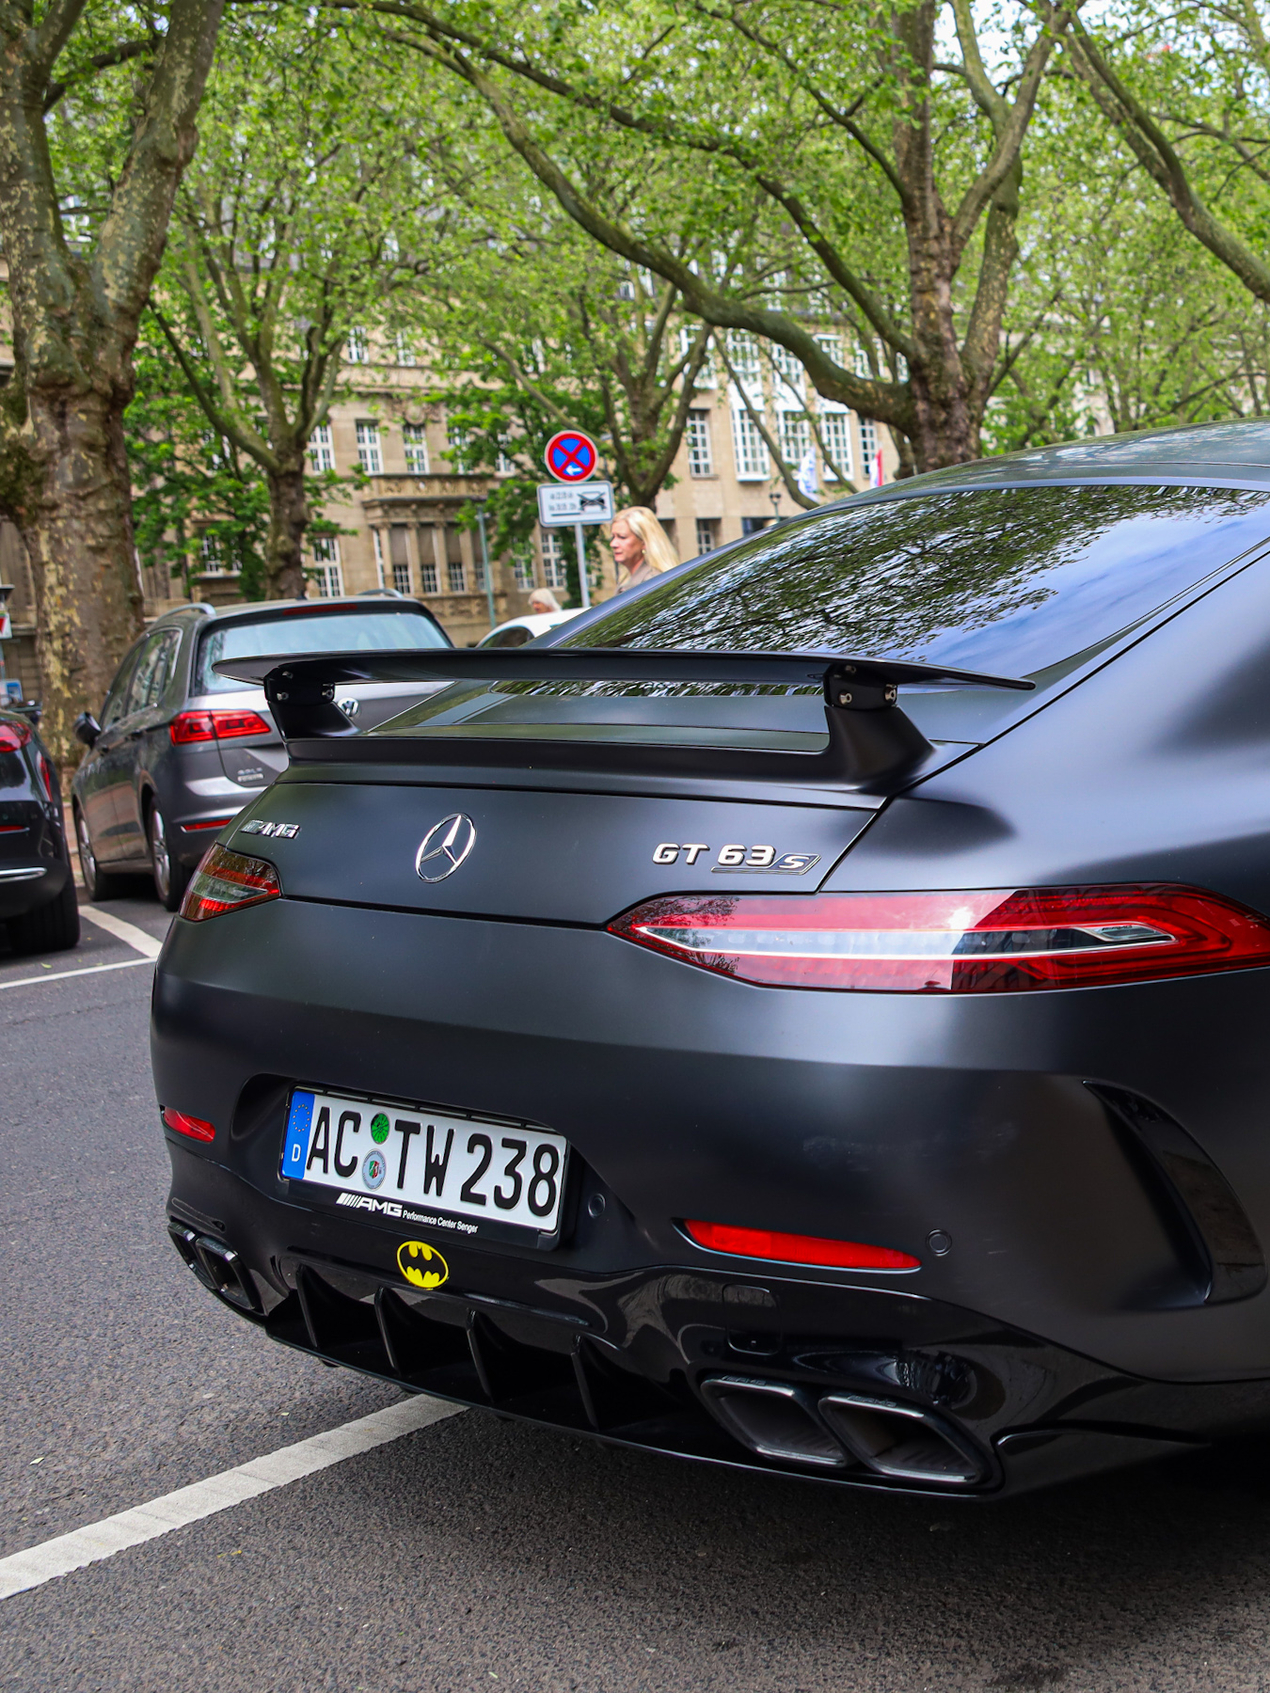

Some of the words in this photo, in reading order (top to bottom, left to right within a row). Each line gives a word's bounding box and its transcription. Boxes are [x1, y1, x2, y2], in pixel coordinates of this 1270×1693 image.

[652, 843, 710, 865] GT
[717, 844, 776, 866] 63
[778, 855, 810, 869] S
[290, 1143, 302, 1163] D
[306, 1106, 362, 1178] AC
[355, 1196, 403, 1218] AMG
[402, 1209, 437, 1226] Performance
[437, 1216, 457, 1229] Center
[456, 1220, 479, 1235] Senger
